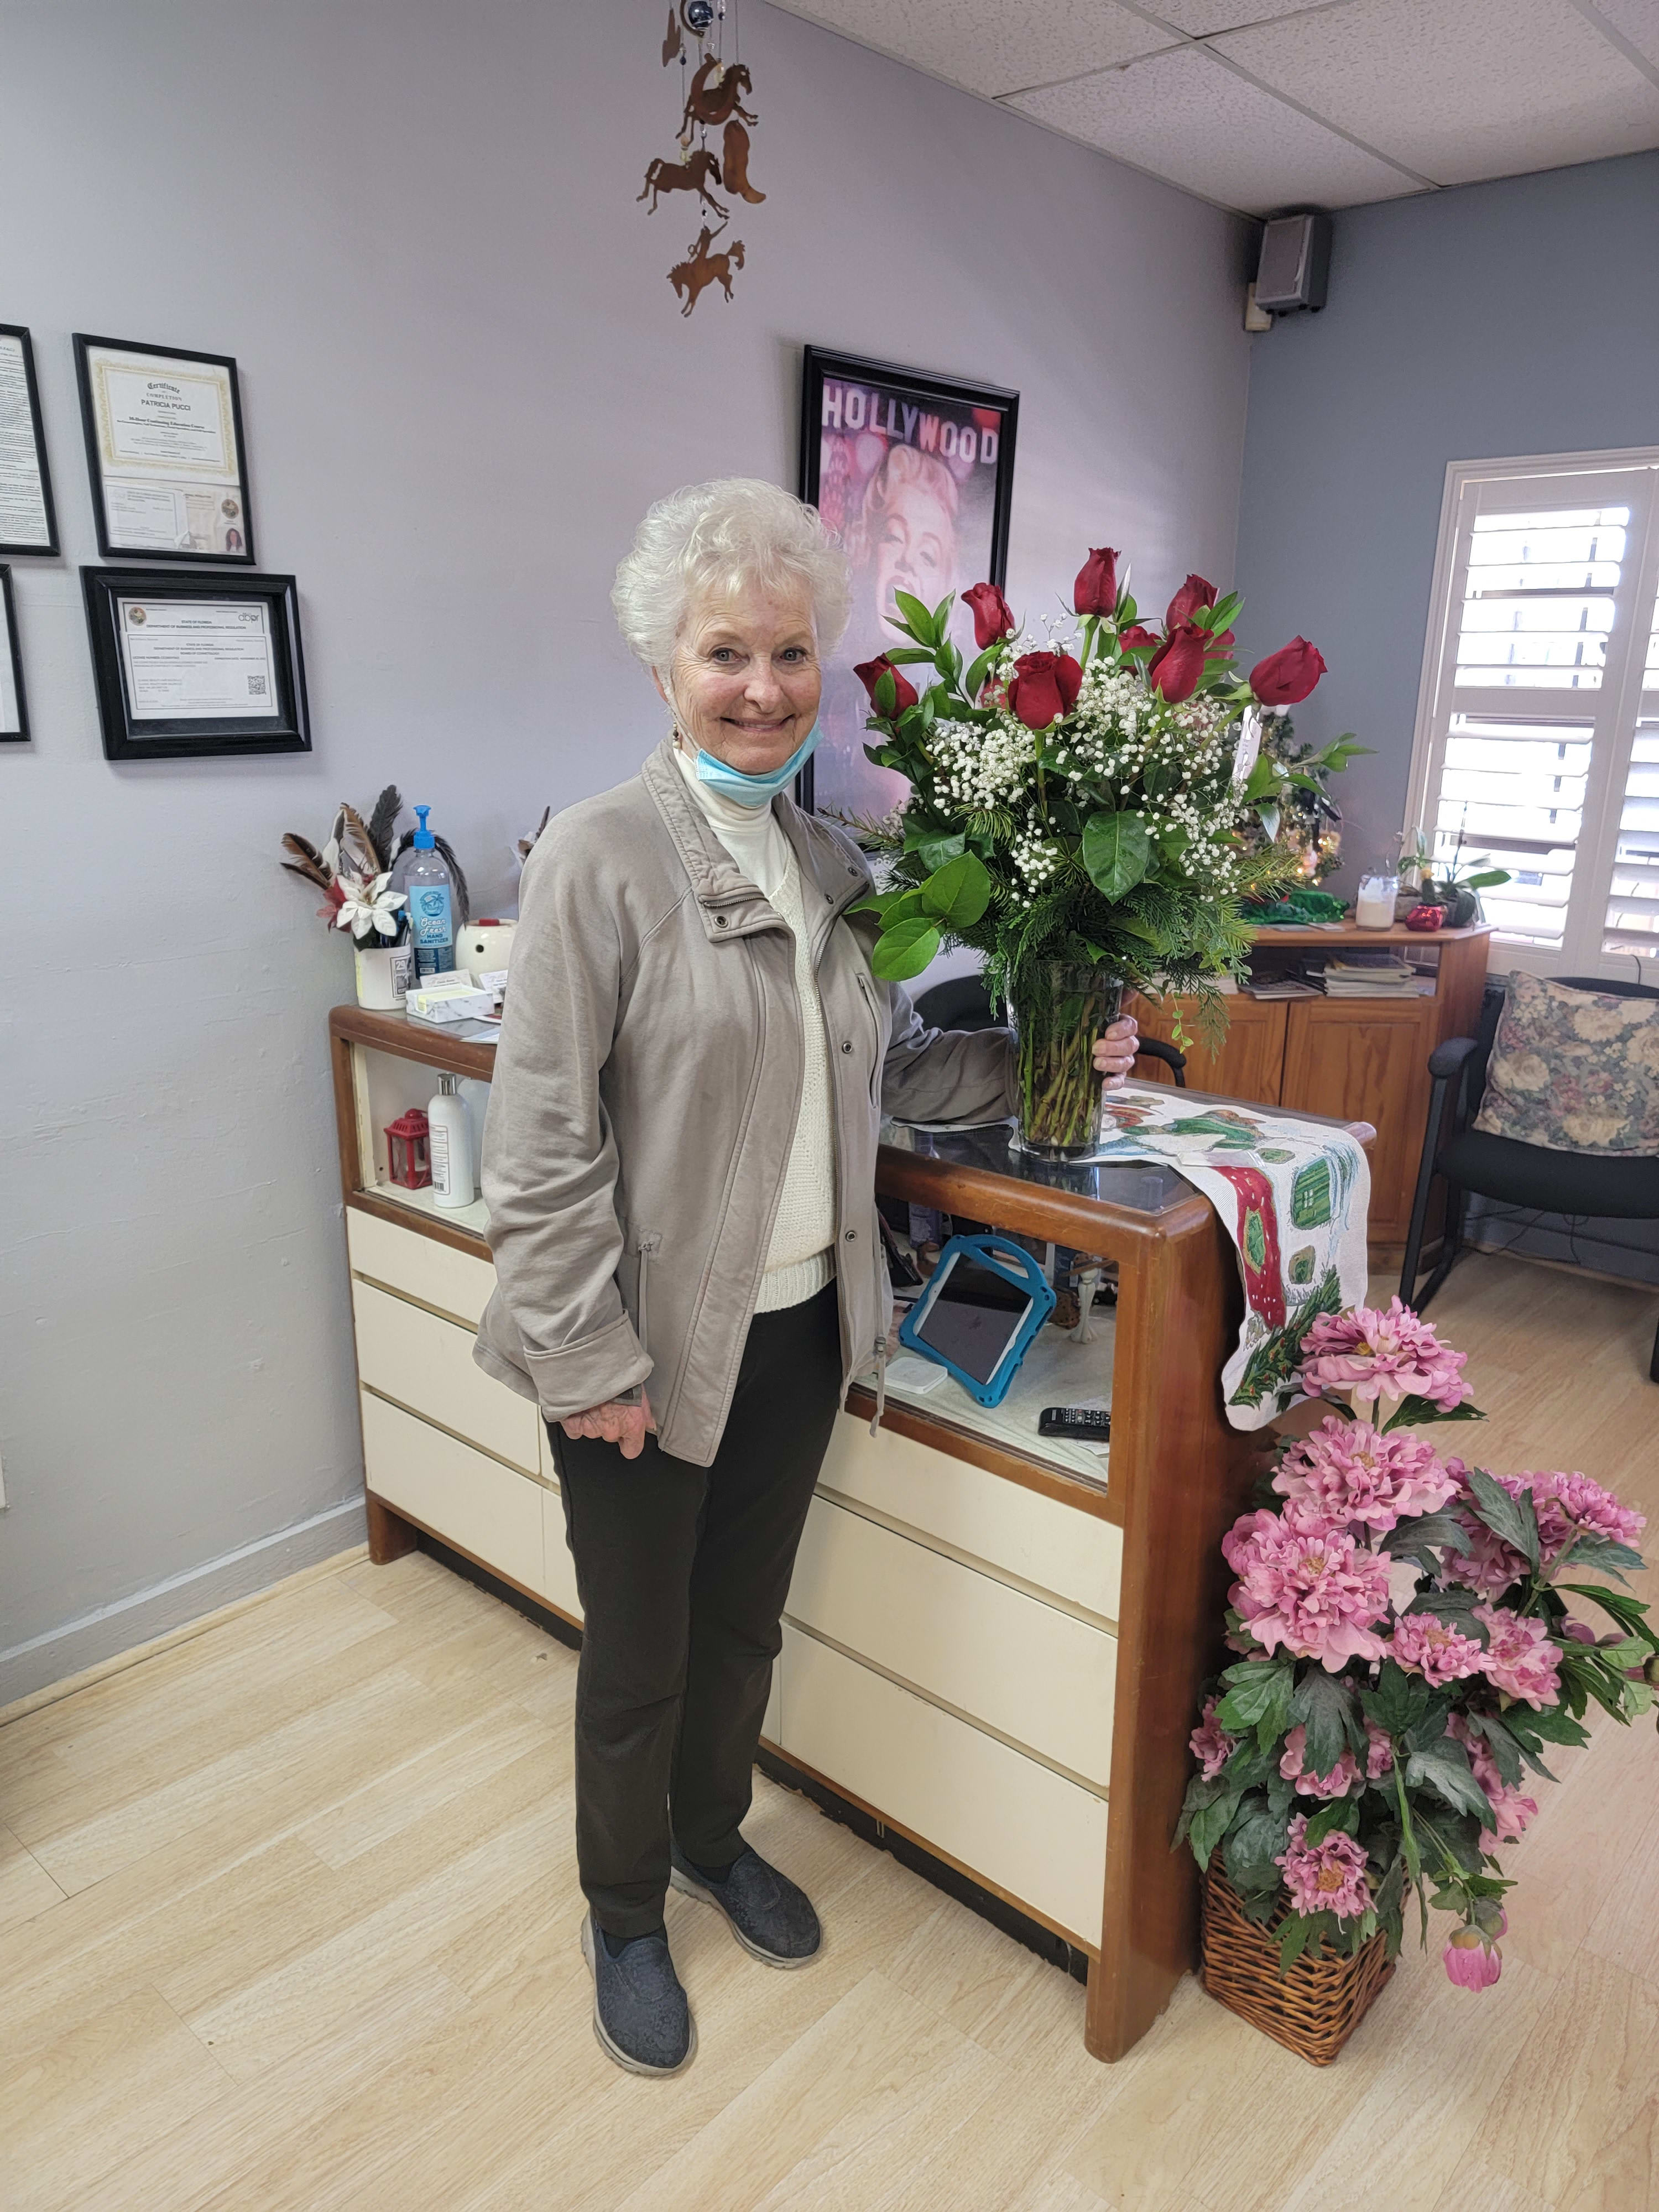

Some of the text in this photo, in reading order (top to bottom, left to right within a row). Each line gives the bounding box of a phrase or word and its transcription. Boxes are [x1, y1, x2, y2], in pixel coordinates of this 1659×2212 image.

[147, 382, 180, 394] Certificate
[146, 393, 182, 401] COMPLETION
[141, 399, 171, 408] PATRICIA
[821, 384, 999, 464] HOLLYWOOD
[421, 917, 446, 927] Ocean
[420, 926, 447, 937] Fresh
